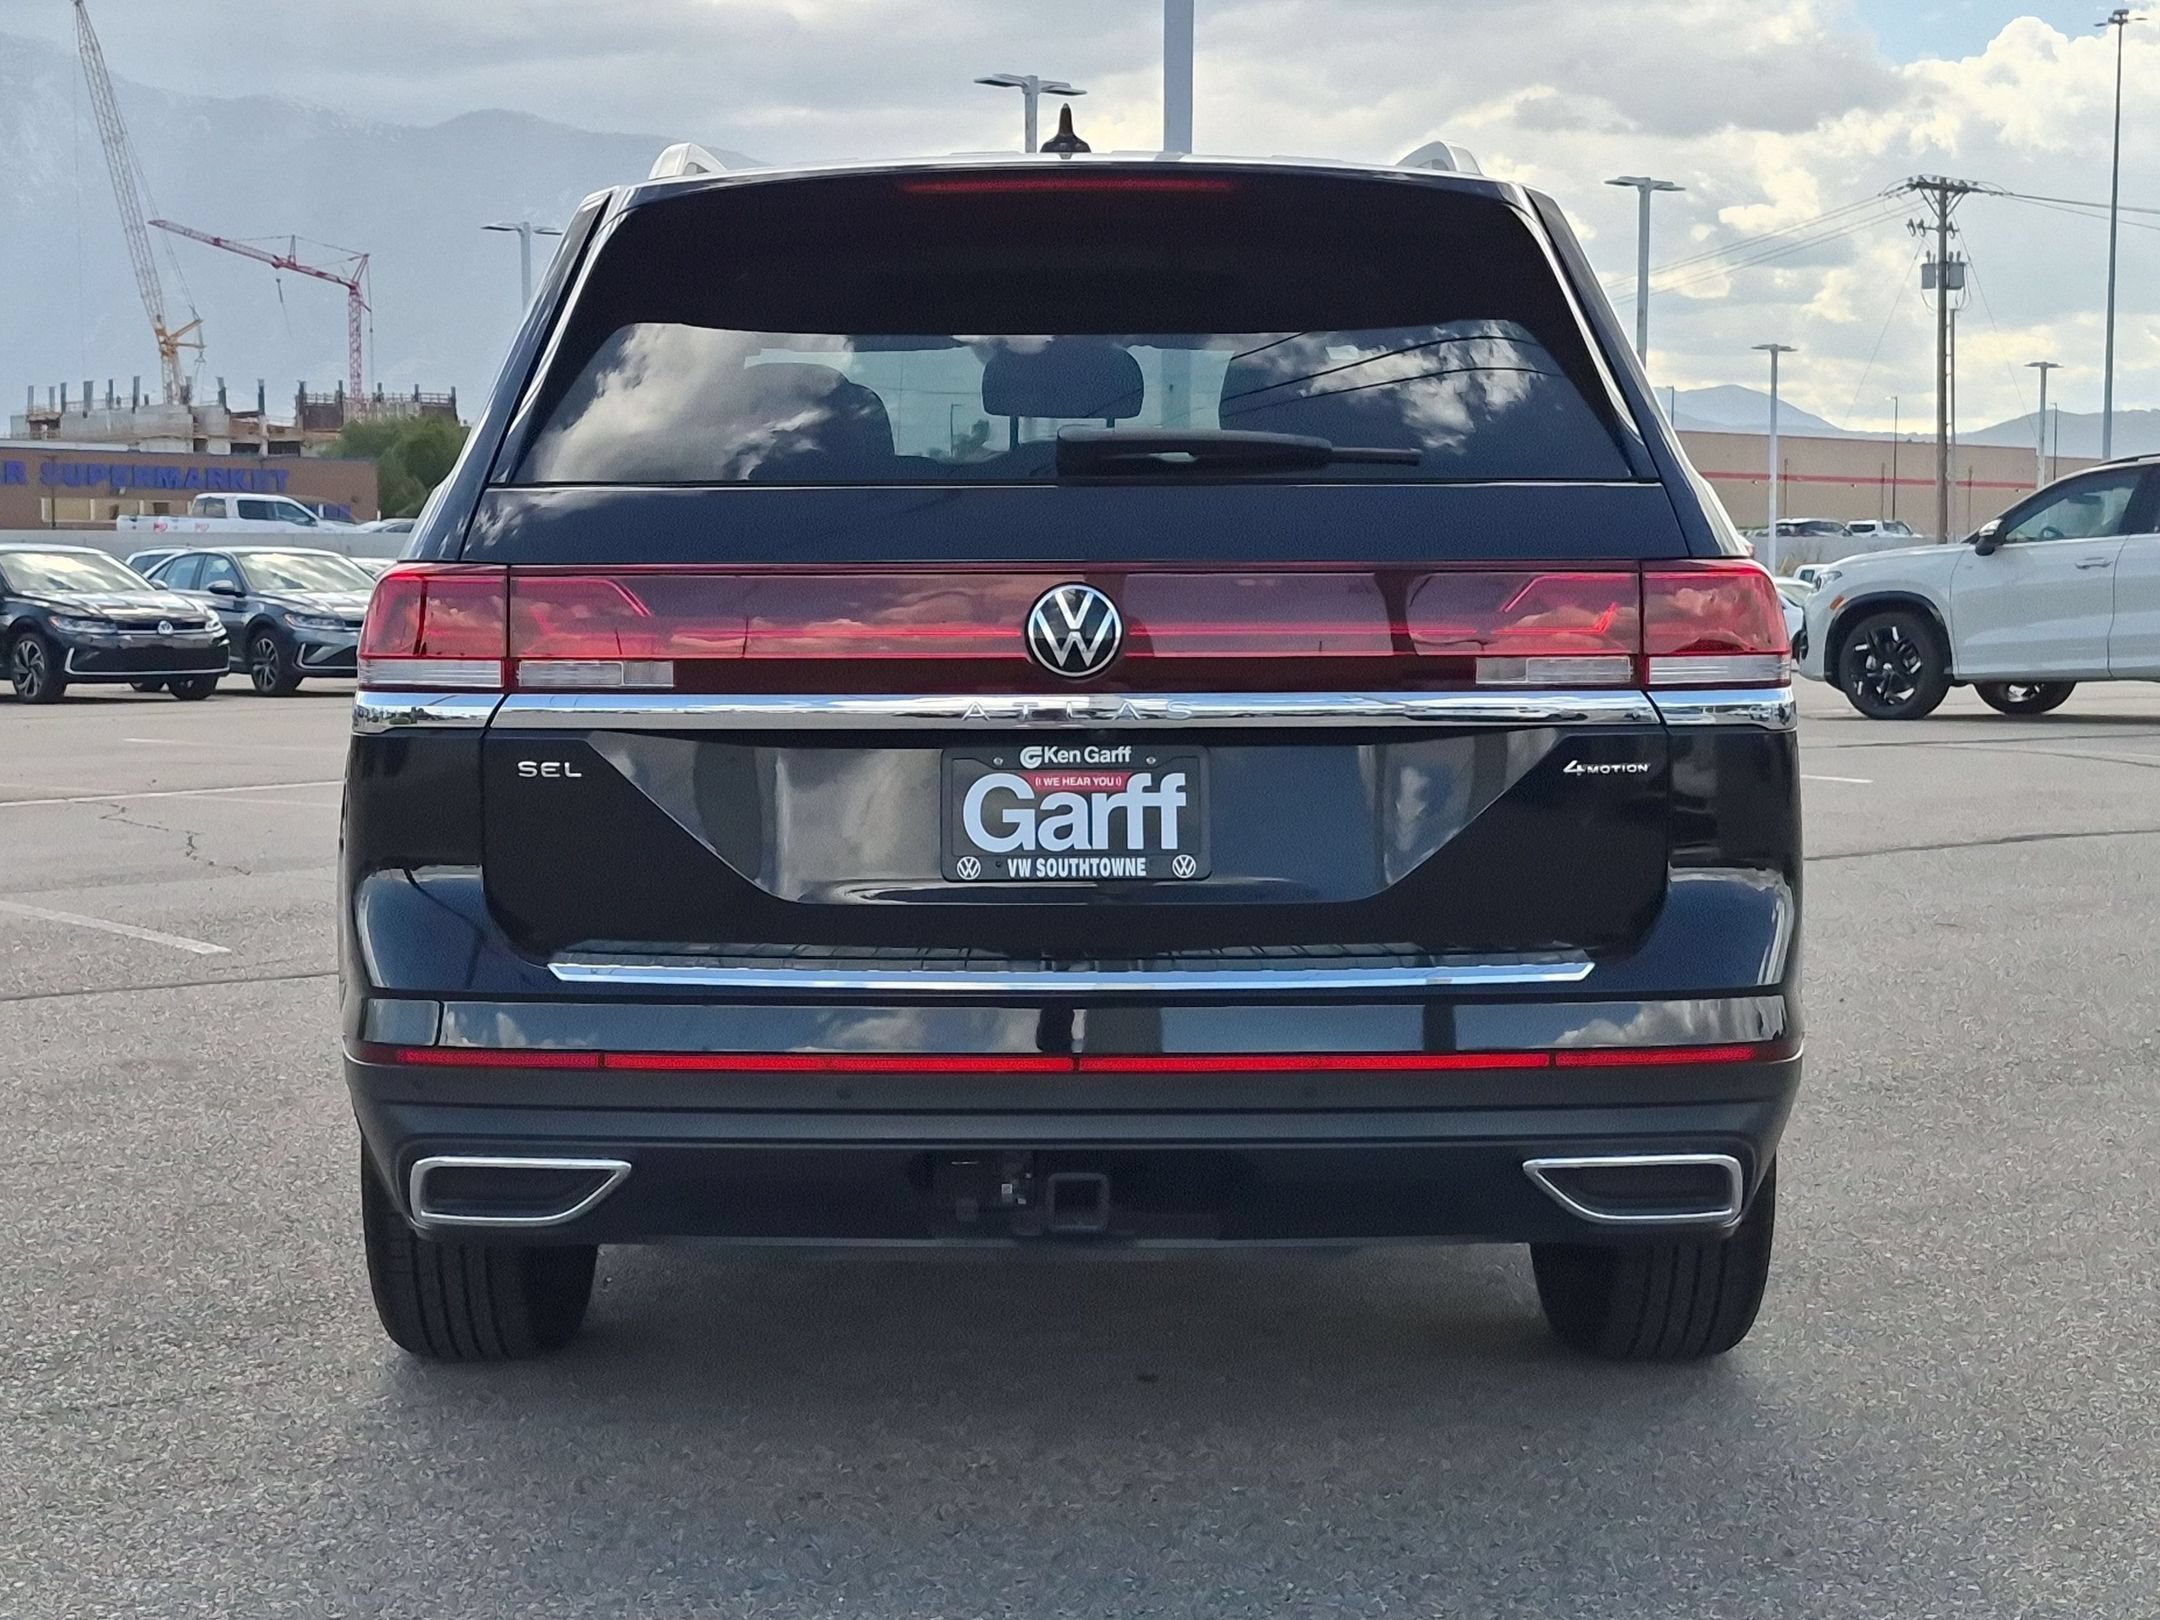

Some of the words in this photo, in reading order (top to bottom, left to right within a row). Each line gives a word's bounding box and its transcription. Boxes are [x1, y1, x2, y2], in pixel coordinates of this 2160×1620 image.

[40, 462, 289, 493] SUPERMARKET
[960, 700, 1193, 721] ATLAS
[1044, 745, 1081, 763] Ken
[1084, 745, 1132, 763] Garff
[517, 760, 583, 778] SEL
[1562, 759, 1651, 776] 4MOTION
[1044, 777, 1060, 787] WE
[1062, 776, 1091, 787] HEAR
[1092, 776, 1115, 786] YOU
[963, 772, 1187, 853] Garff
[1007, 858, 1032, 878] VW
[1036, 857, 1147, 877] SOUTHTOWNE
